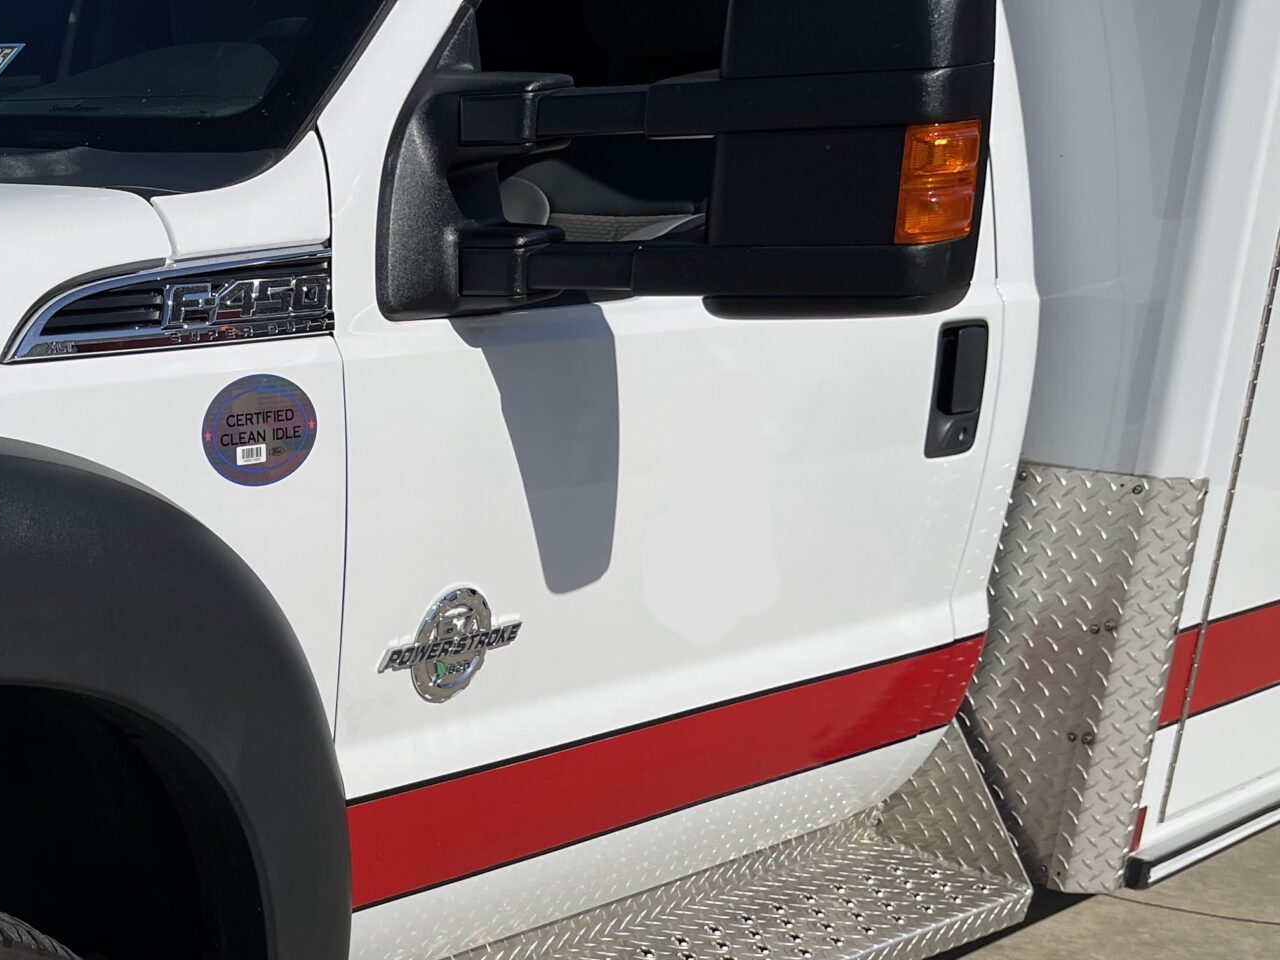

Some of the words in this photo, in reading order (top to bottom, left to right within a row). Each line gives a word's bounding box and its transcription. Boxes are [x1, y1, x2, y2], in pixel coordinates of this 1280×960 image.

[162, 274, 331, 330] F-450
[170, 326, 254, 344] SUPER
[267, 318, 330, 335] DUTY
[226, 408, 295, 428] CERTIFIED
[220, 430, 266, 447] CLEAN
[272, 426, 302, 441] IDLE
